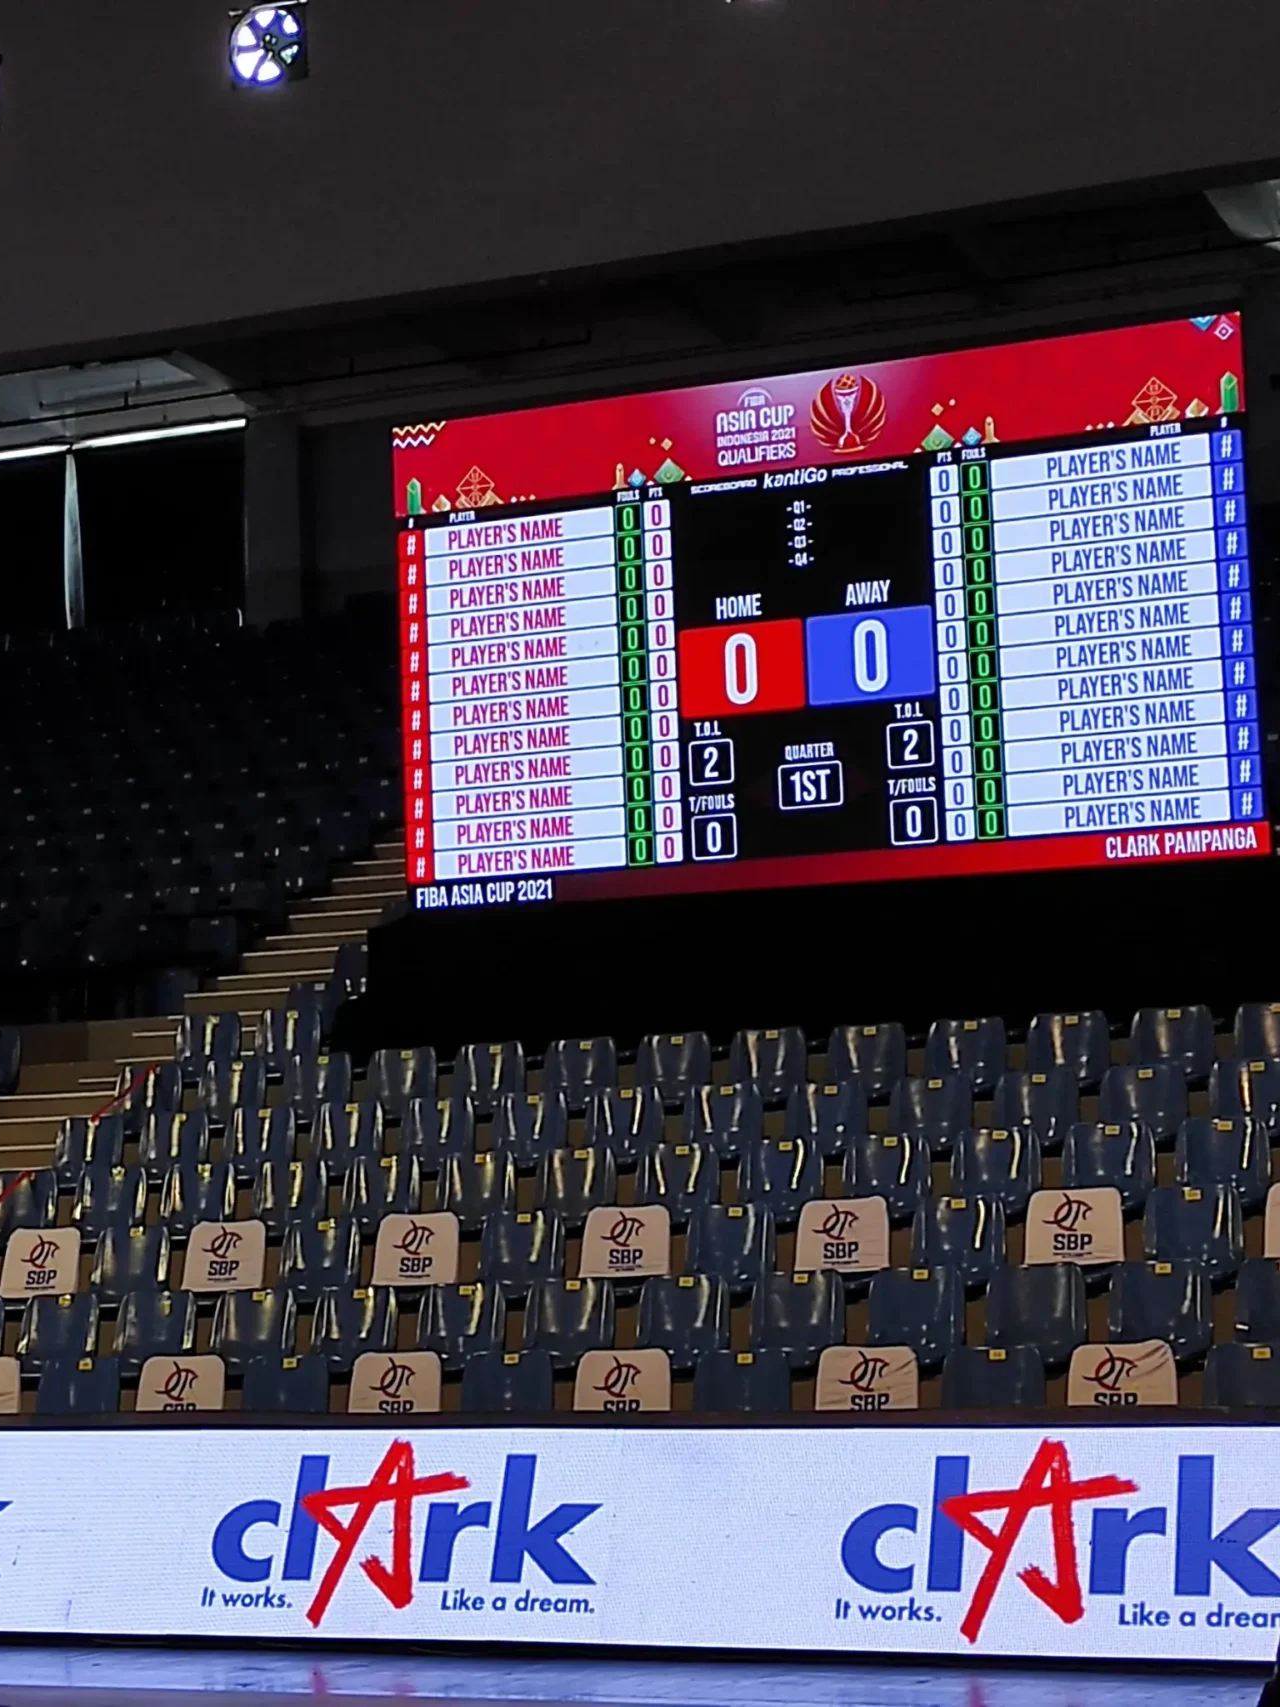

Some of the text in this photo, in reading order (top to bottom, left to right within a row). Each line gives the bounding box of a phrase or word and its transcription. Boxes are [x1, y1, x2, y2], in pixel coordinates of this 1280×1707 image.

[744, 396, 766, 408] FIBA
[716, 404, 794, 434] ASIA CUP
[1150, 422, 1181, 437] PLAYER
[717, 427, 796, 448] INDONESIA 2021
[718, 442, 796, 466] QUALIFIERS
[962, 447, 986, 460] FOULS
[1047, 442, 1181, 478] PLAYER'S NAME
[648, 487, 663, 498] PTS
[938, 470, 950, 492] 0
[1049, 474, 1183, 510] PLAYER'S NAME
[449, 511, 476, 523] PLAYER
[651, 504, 662, 526] 0
[940, 501, 951, 523] 0
[1050, 507, 1185, 542] PLAYER'S NAME
[448, 518, 563, 550] PLAYER'S NAME
[652, 534, 663, 557] 0
[941, 532, 952, 555] 0
[449, 548, 564, 580] PLAYER'S NAME
[1052, 539, 1186, 574] PLAYER'S NAME
[653, 564, 664, 587] 0
[1053, 572, 1188, 606] PLAYER'S NAME
[450, 578, 565, 609] PLAYER'S NAME
[716, 593, 762, 620] HOME
[846, 580, 890, 606] AWAY
[451, 608, 566, 638] PLAYER'S NAME
[1055, 604, 1190, 638] PLAYER'S NAME
[452, 637, 567, 668] PLAYER'S NAME
[853, 619, 888, 693] 0
[1056, 636, 1192, 669] PLAYER'S NAME
[452, 667, 568, 698] PLAYER'S NAME
[724, 633, 758, 704] 0
[1058, 668, 1194, 701] PLAYER'S NAME
[454, 697, 569, 727] PLAYER'S NAME
[1060, 701, 1196, 733] PLAYER'S NAME
[454, 727, 570, 756] PLAYER'S NAME
[784, 742, 834, 760] QUARTER
[902, 728, 919, 761] 2
[1061, 733, 1197, 765] PLAYER'S NAME
[455, 756, 571, 786] PLAYER'S NAME
[704, 746, 719, 778] 2
[790, 769, 830, 802] 1ST
[887, 776, 936, 796] T/FOULS
[1063, 766, 1199, 797] PLAYER'S NAME
[456, 786, 572, 816] PLAYER'S NAME
[689, 794, 734, 813] T/FOULS
[1064, 798, 1201, 828] PLAYER'S NAME
[457, 816, 574, 845] PLAYER'S NAME
[906, 806, 921, 838] 0
[954, 814, 966, 837] 0
[664, 836, 674, 859] 0
[706, 822, 722, 853] 0
[1106, 826, 1258, 858] CLARK PAMPANGA
[458, 846, 574, 874] PLAYER'S NAME
[416, 878, 552, 908] FIBA ASIA CUP 2021
[609, 1248, 643, 1264] SBP
[823, 1242, 859, 1259] SBP
[1053, 1233, 1093, 1251] SBP
[26, 1270, 57, 1285] SBP
[208, 1260, 240, 1276] SBP
[399, 1256, 433, 1272] SBP
[851, 1393, 890, 1411] SBP
[201, 1587, 292, 1608] It works.
[441, 1589, 595, 1614] Like a dream.
[835, 1597, 942, 1622] It works.
[1120, 1602, 1170, 1626] Like
[1180, 1610, 1196, 1627] a
